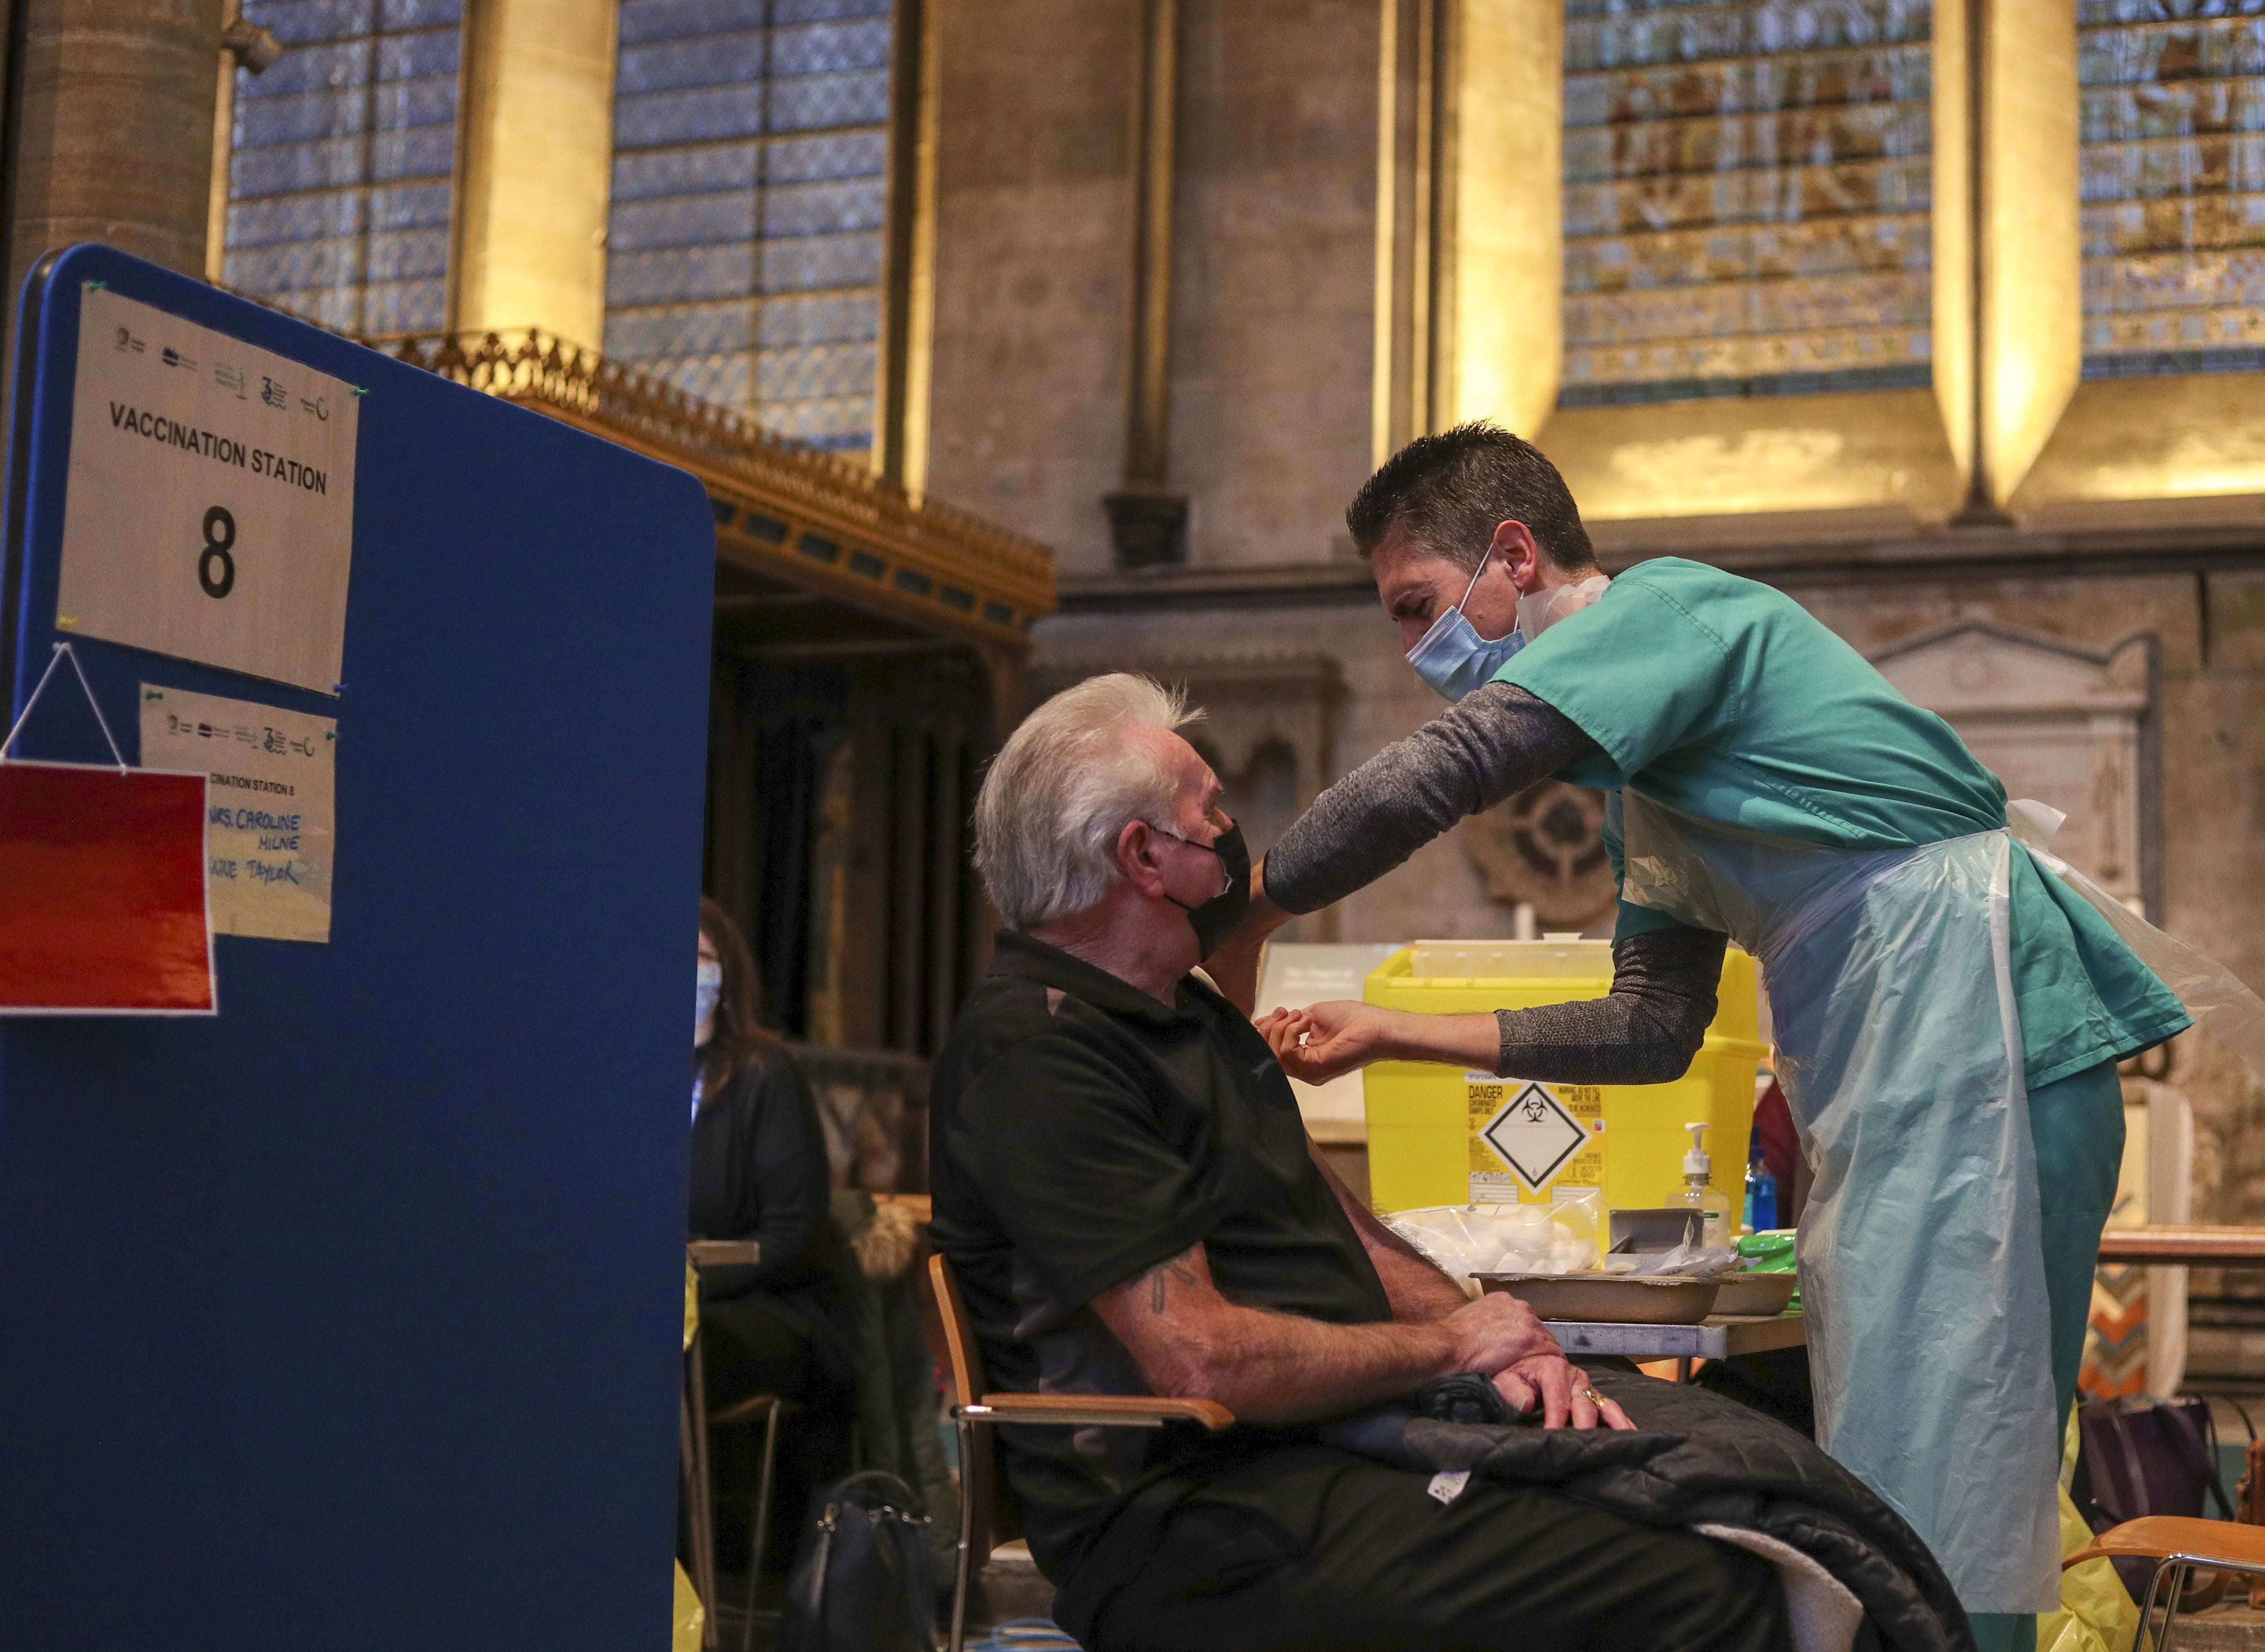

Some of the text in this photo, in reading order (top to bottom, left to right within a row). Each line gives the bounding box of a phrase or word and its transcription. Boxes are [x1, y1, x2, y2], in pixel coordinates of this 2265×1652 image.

[109, 401, 327, 496] VACCINATION STATION
[198, 505, 236, 599] 8
[210, 773, 294, 796] CINATION STATION 8
[236, 808, 301, 831] CAROLINE
[247, 858, 299, 887] TAYLOR
[1469, 1085, 1502, 1099] DANGER
[1532, 1166, 1538, 1176] 6
